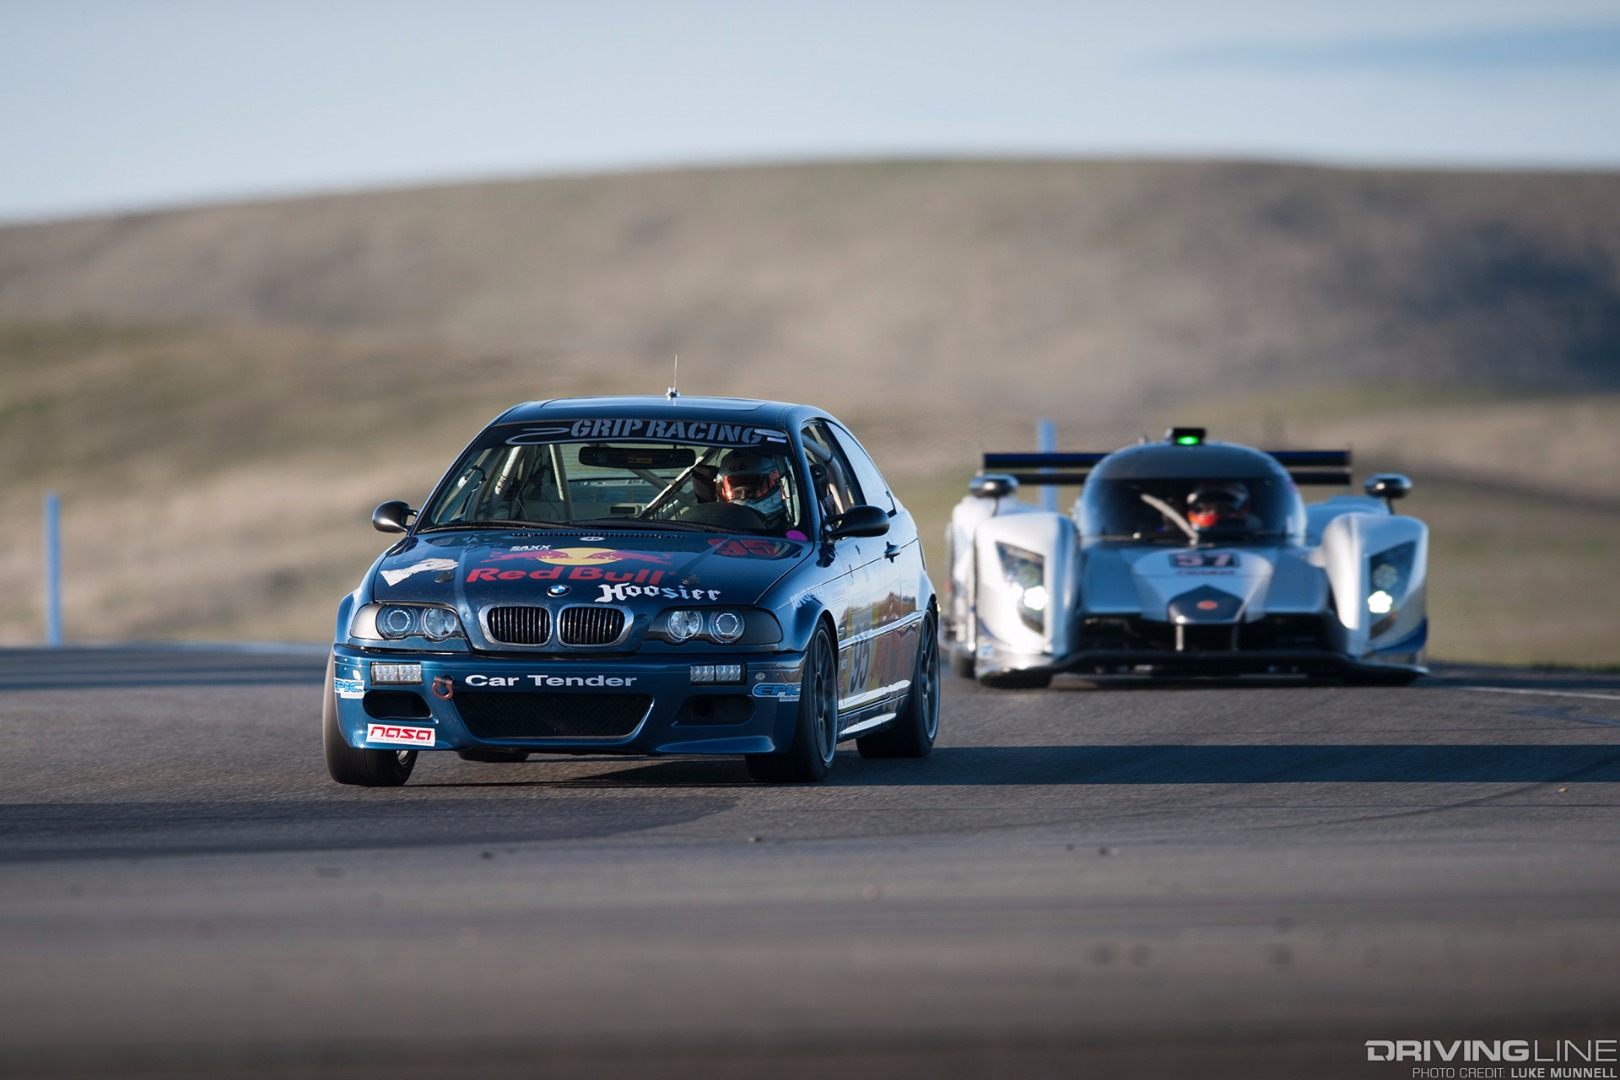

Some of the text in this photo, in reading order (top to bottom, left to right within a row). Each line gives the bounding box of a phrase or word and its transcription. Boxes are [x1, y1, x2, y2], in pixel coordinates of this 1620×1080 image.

[570, 419, 644, 437] GRIP
[647, 420, 762, 444] RACING
[707, 537, 777, 557] 95
[465, 566, 665, 585] Red Bull
[594, 582, 722, 603] Hoosier
[334, 679, 363, 693] PIC
[465, 674, 637, 687] Car Tender
